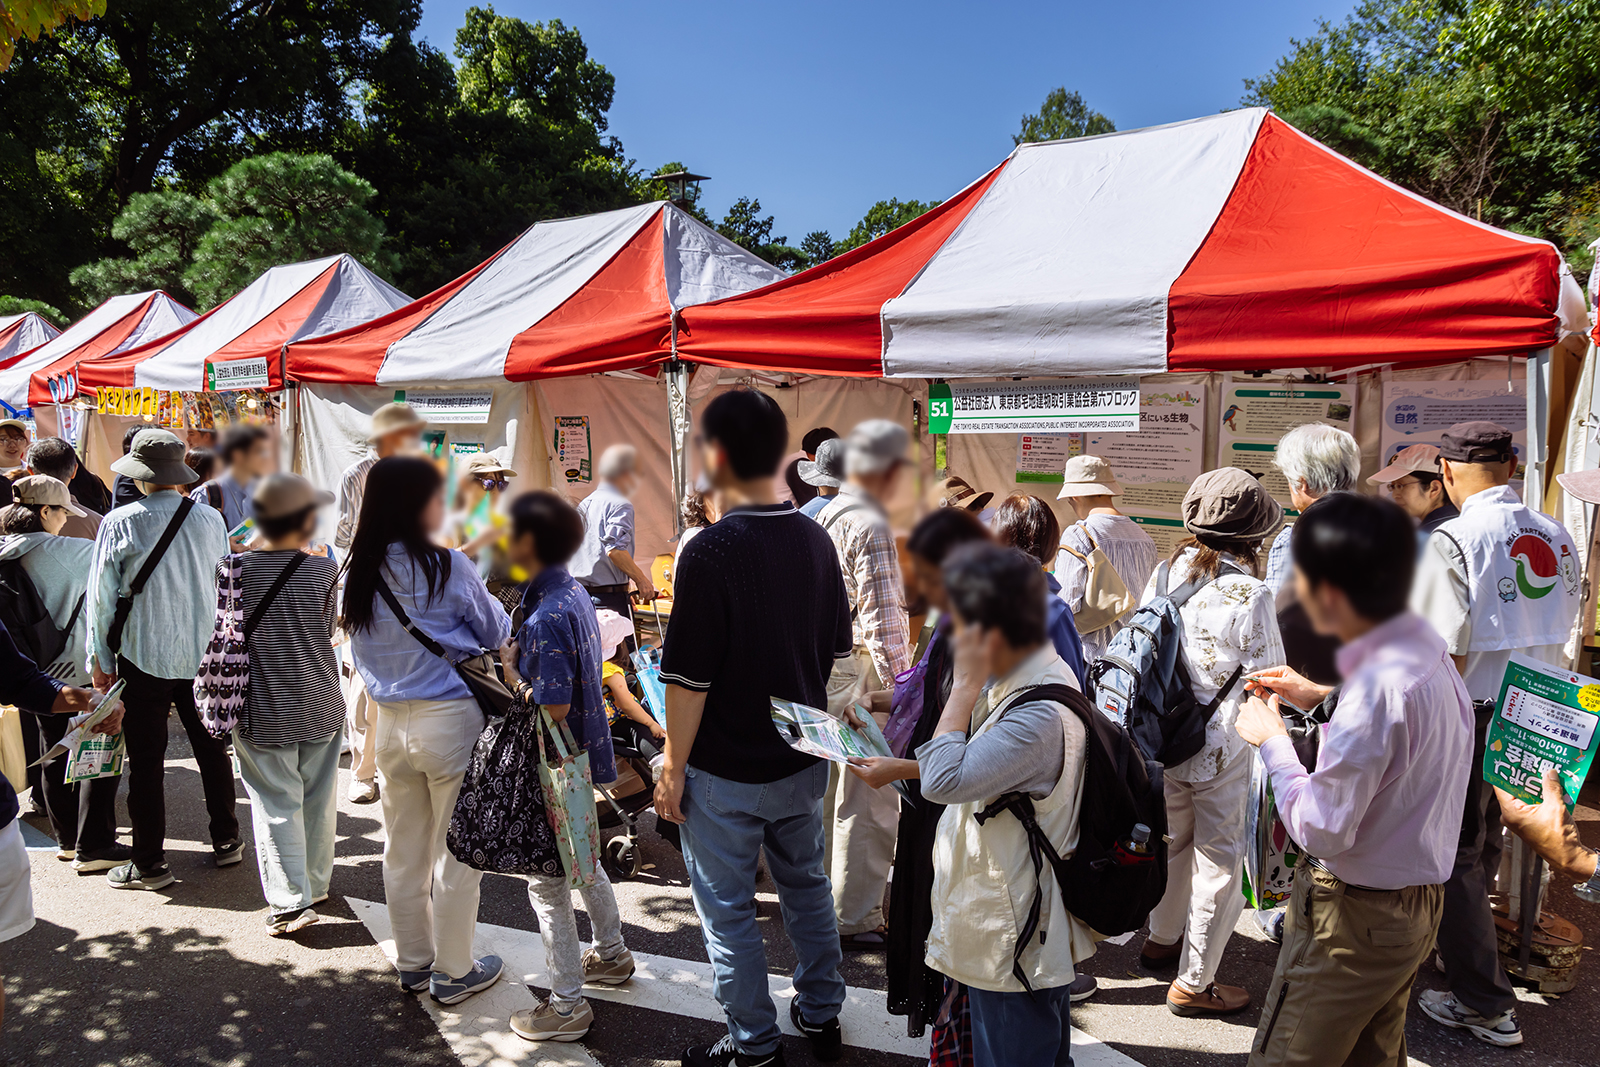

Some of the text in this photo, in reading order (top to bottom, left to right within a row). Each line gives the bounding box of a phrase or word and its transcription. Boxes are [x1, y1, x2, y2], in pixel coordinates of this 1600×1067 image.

[208, 372, 214, 382] 50
[931, 401, 949, 417] 51
[954, 391, 1137, 411] 公益社団法人 東京都宅地建物取引業協会第六ブロック
[1394, 413, 1418, 424] 自然
[1506, 528, 1552, 547] REAL PARTNER
[1506, 690, 1519, 717] Ticket
[1526, 717, 1579, 742] 抽選チケット
[1555, 755, 1570, 764] 2026
[1494, 760, 1542, 799] ラポン
